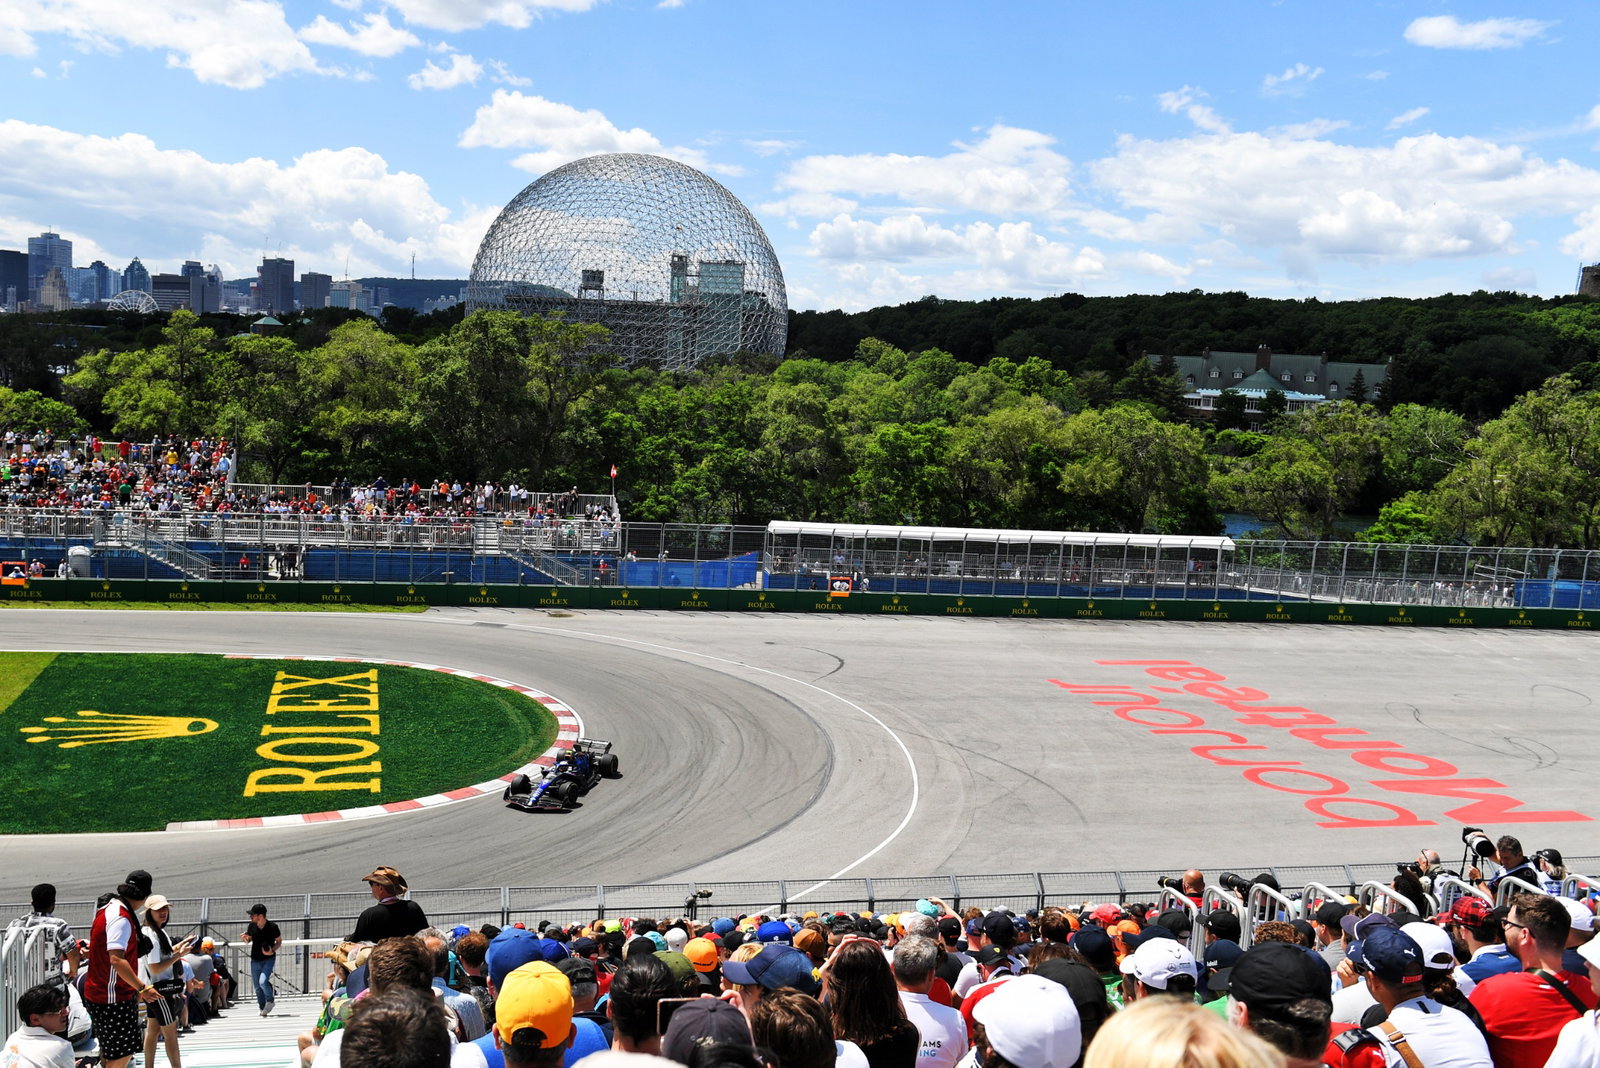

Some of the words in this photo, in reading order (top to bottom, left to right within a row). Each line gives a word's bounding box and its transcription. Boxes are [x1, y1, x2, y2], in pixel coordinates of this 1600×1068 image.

[246, 593, 277, 601] ROLEX
[468, 596, 497, 604] ROLEX
[610, 599, 639, 607] ROLEX
[680, 600, 708, 608] ROLEX
[747, 601, 775, 609] ROLEX
[881, 604, 909, 612] ROLEX
[1327, 614, 1353, 622] ROLEX
[1448, 617, 1473, 625] ROLEX
[243, 668, 382, 797] ROLEX
[1094, 659, 1595, 825] Montréal
[1046, 678, 1440, 829] bonjour
[922, 1040, 942, 1048] AMS
[919, 1049, 937, 1057] ING
